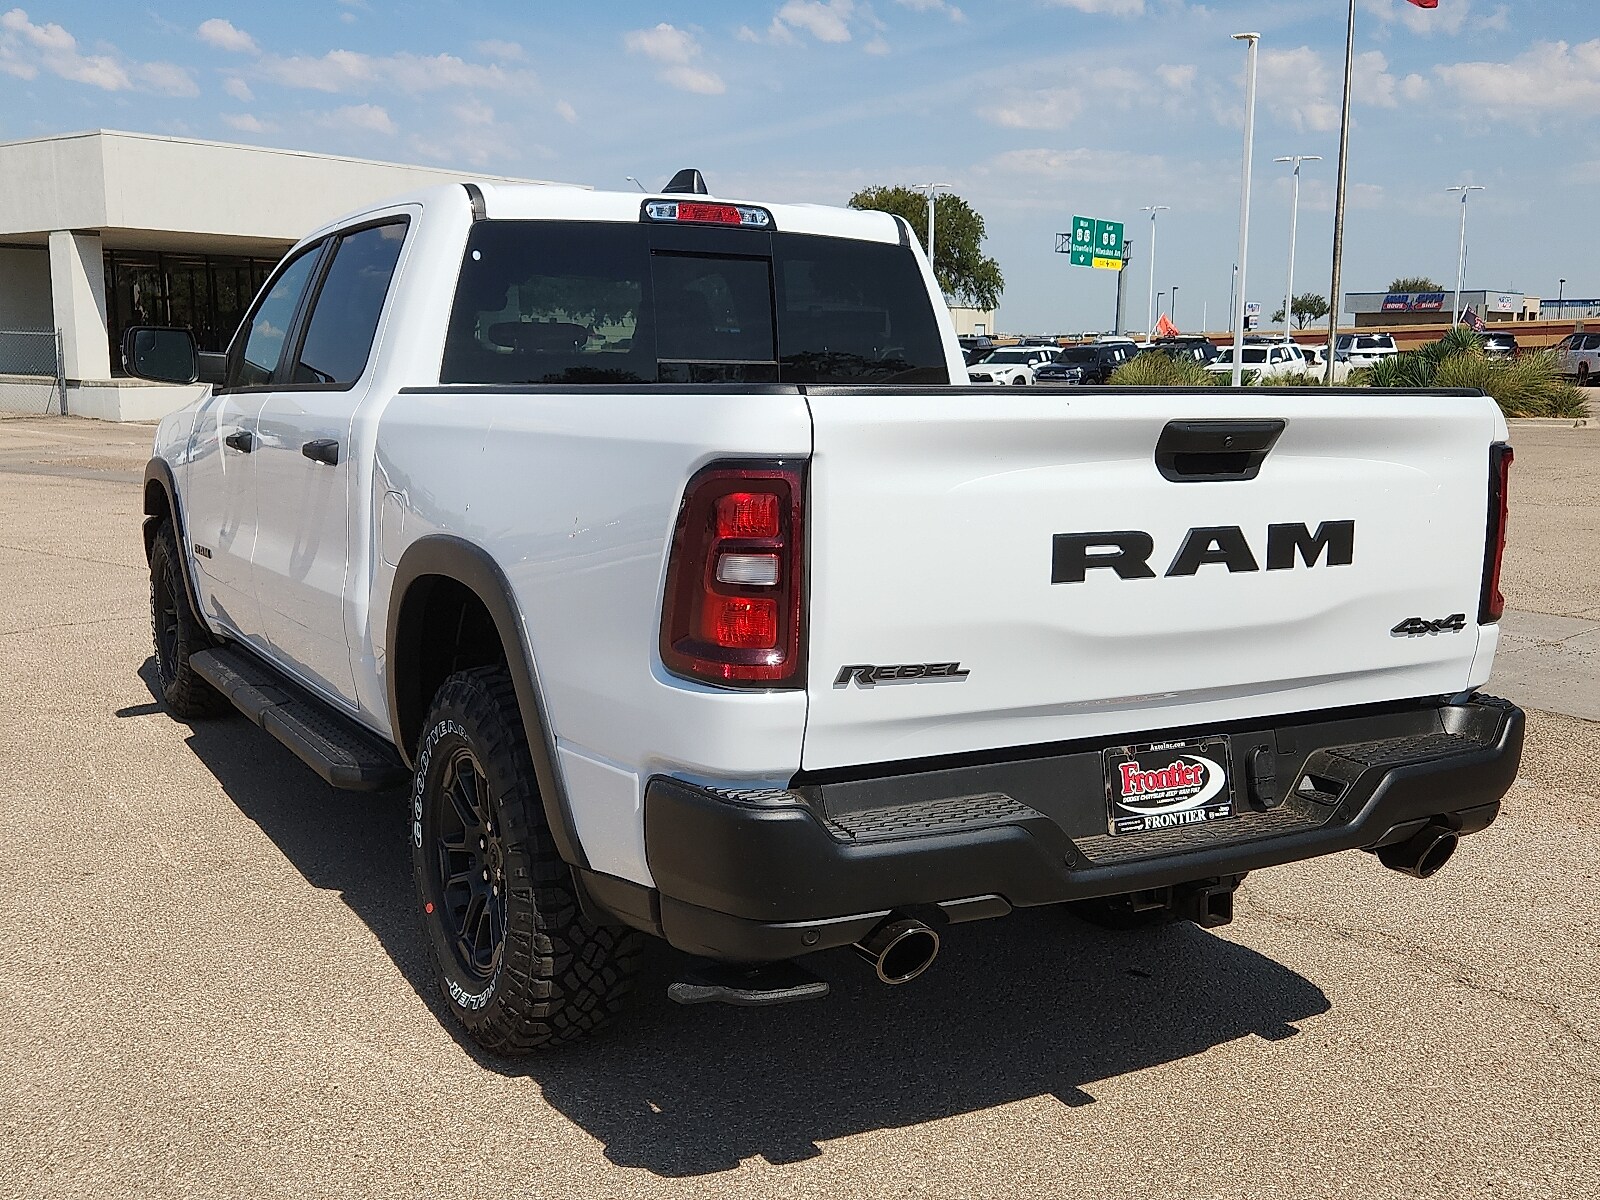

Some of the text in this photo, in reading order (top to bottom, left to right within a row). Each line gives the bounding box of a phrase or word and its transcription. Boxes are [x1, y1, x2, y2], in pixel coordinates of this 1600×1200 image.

[1051, 520, 1355, 585] RAM
[1390, 614, 1467, 638] 4x4
[833, 662, 970, 690] REBEL
[414, 720, 470, 848] GOODYEAR
[1120, 760, 1204, 796] Frontier
[1144, 808, 1206, 830] FRONTIER
